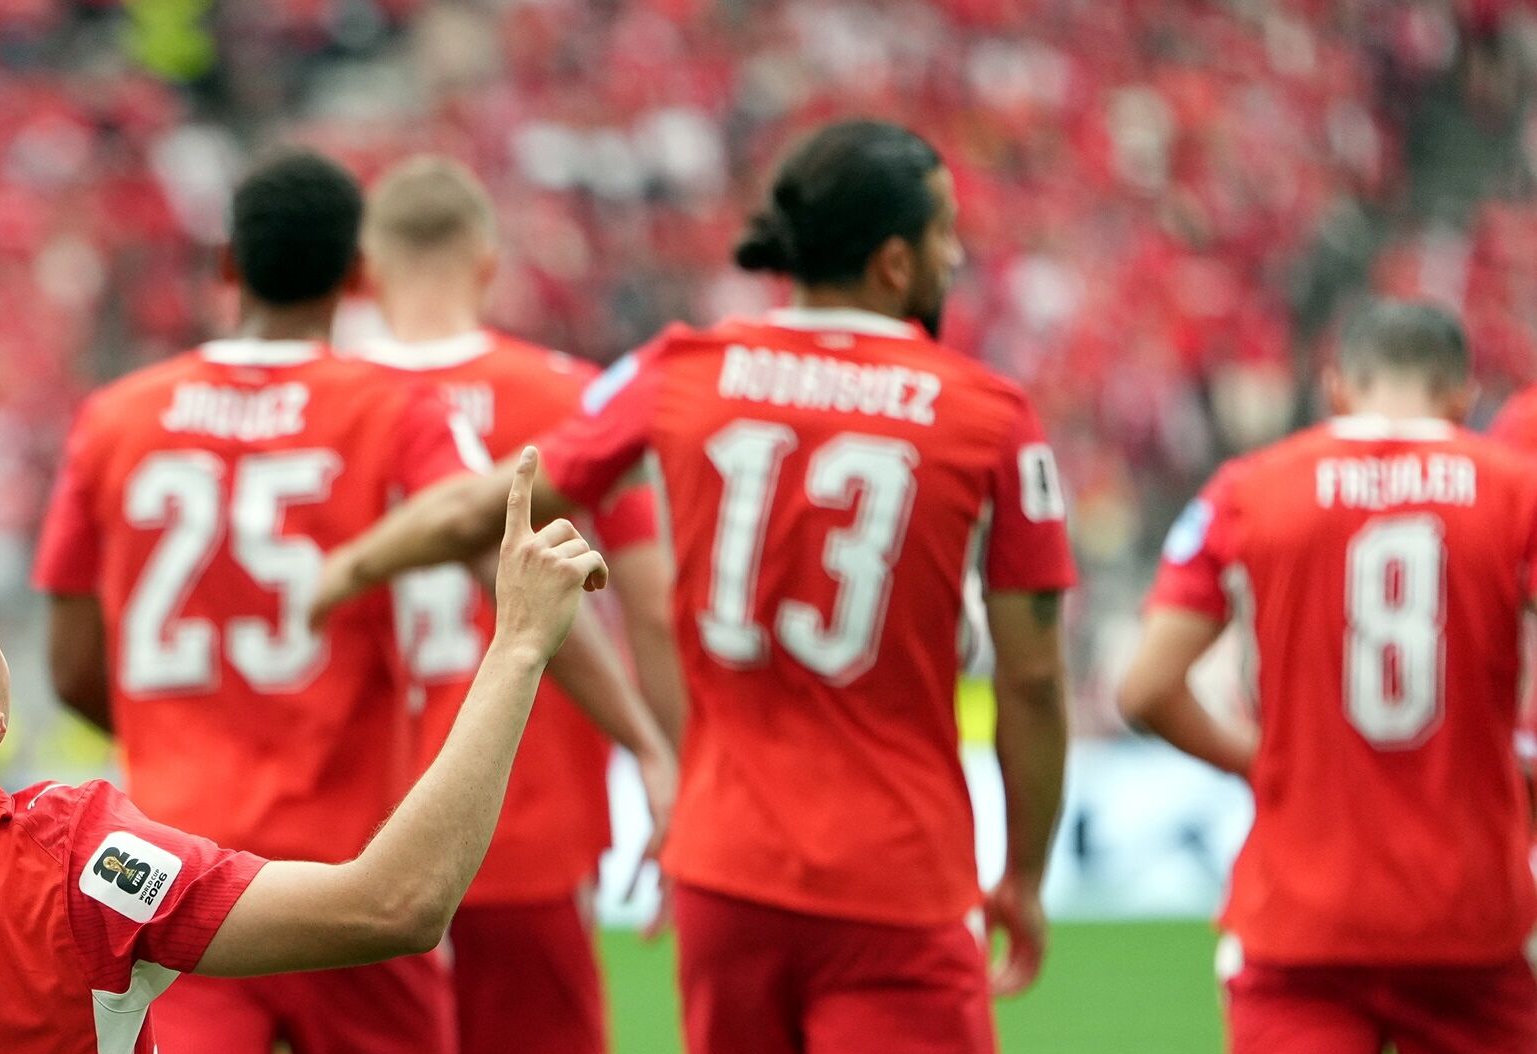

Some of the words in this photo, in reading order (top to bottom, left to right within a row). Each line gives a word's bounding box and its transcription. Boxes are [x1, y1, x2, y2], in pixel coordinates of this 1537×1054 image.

[117, 446, 344, 701] 25
[697, 418, 921, 688] 13
[1342, 512, 1447, 751] 8
[132, 871, 145, 887] FIFA
[139, 879, 153, 901] WORLD
[151, 868, 160, 881] CUP
[145, 872, 168, 906] 2026
